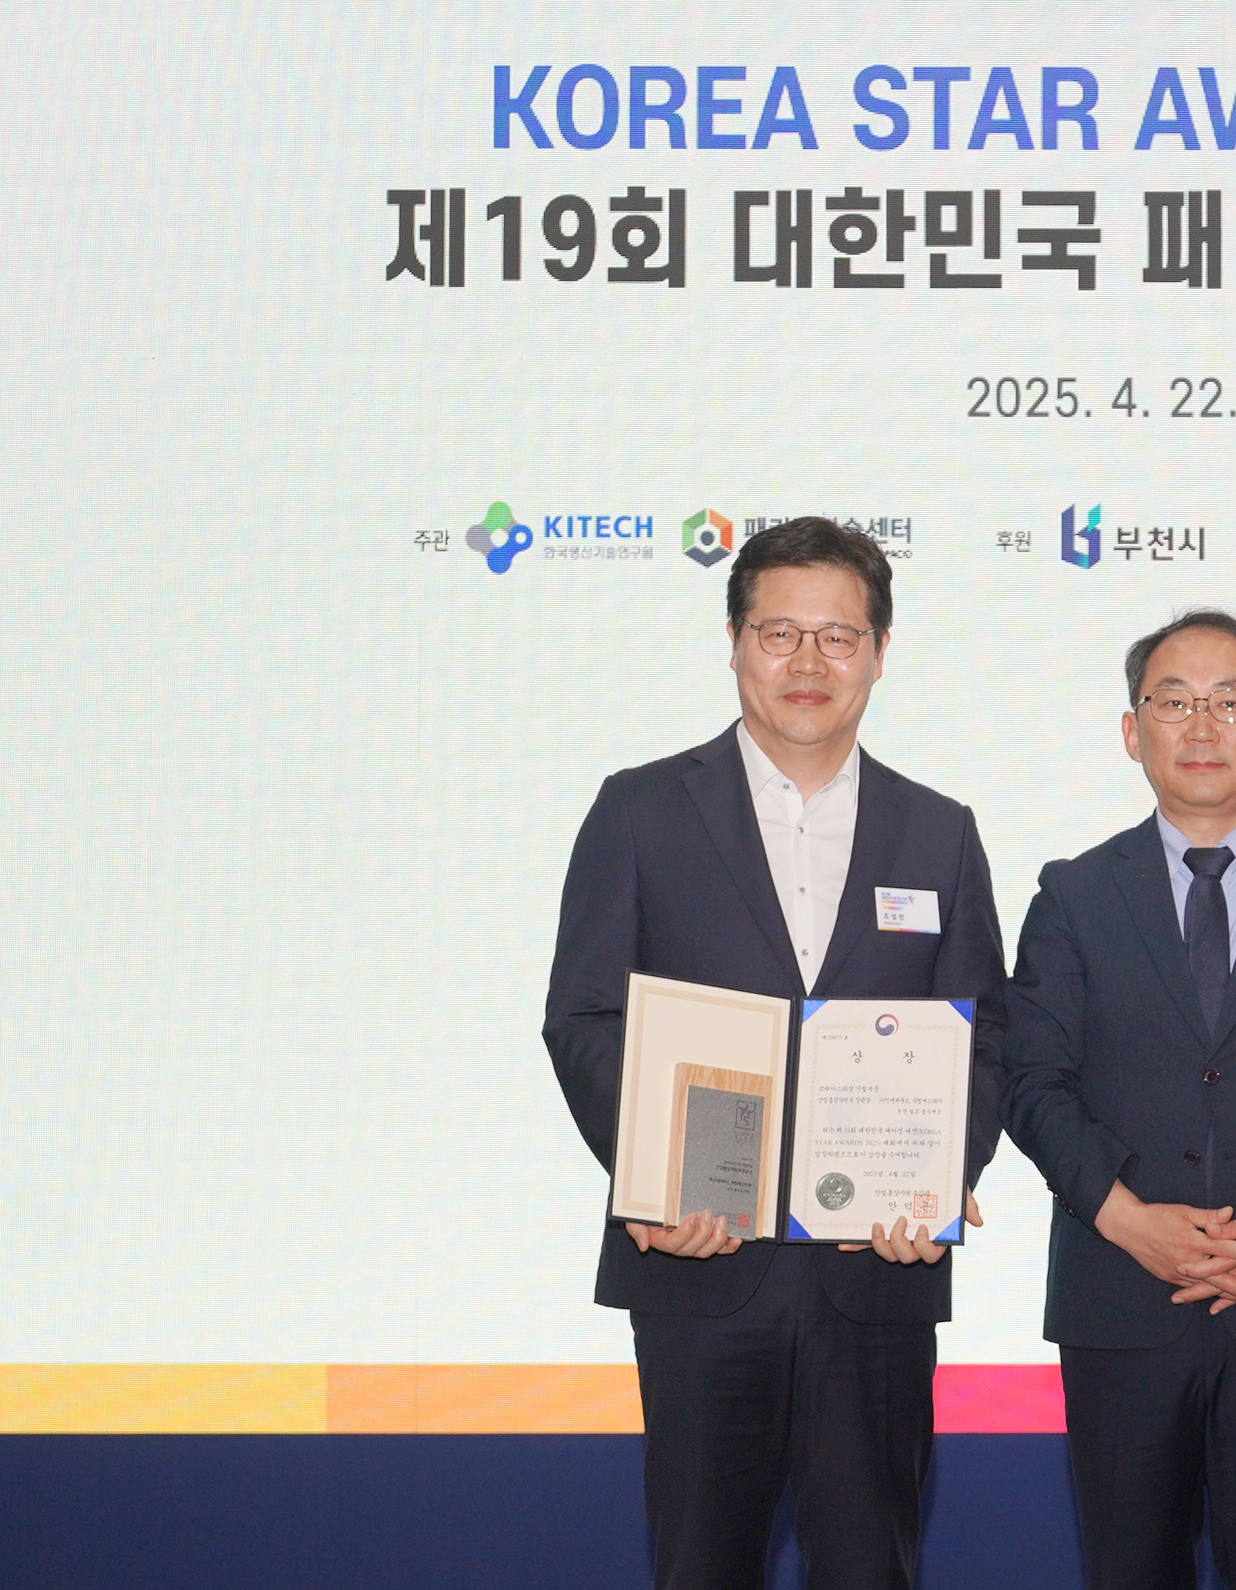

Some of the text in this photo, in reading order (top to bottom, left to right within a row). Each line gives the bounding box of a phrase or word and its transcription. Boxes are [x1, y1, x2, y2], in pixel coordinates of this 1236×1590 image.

[493, 64, 819, 150] KOREA
[852, 65, 1100, 151] STAR
[385, 185, 687, 289] 제19회
[733, 186, 1101, 290] 대한민국
[966, 377, 1092, 418] 2025.
[1111, 377, 1150, 418] 4.
[1170, 377, 1236, 418] 22.
[414, 530, 449, 551] 주관
[544, 516, 653, 538] KITECH
[996, 530, 1031, 553] 후원
[1113, 527, 1205, 561] 부천시
